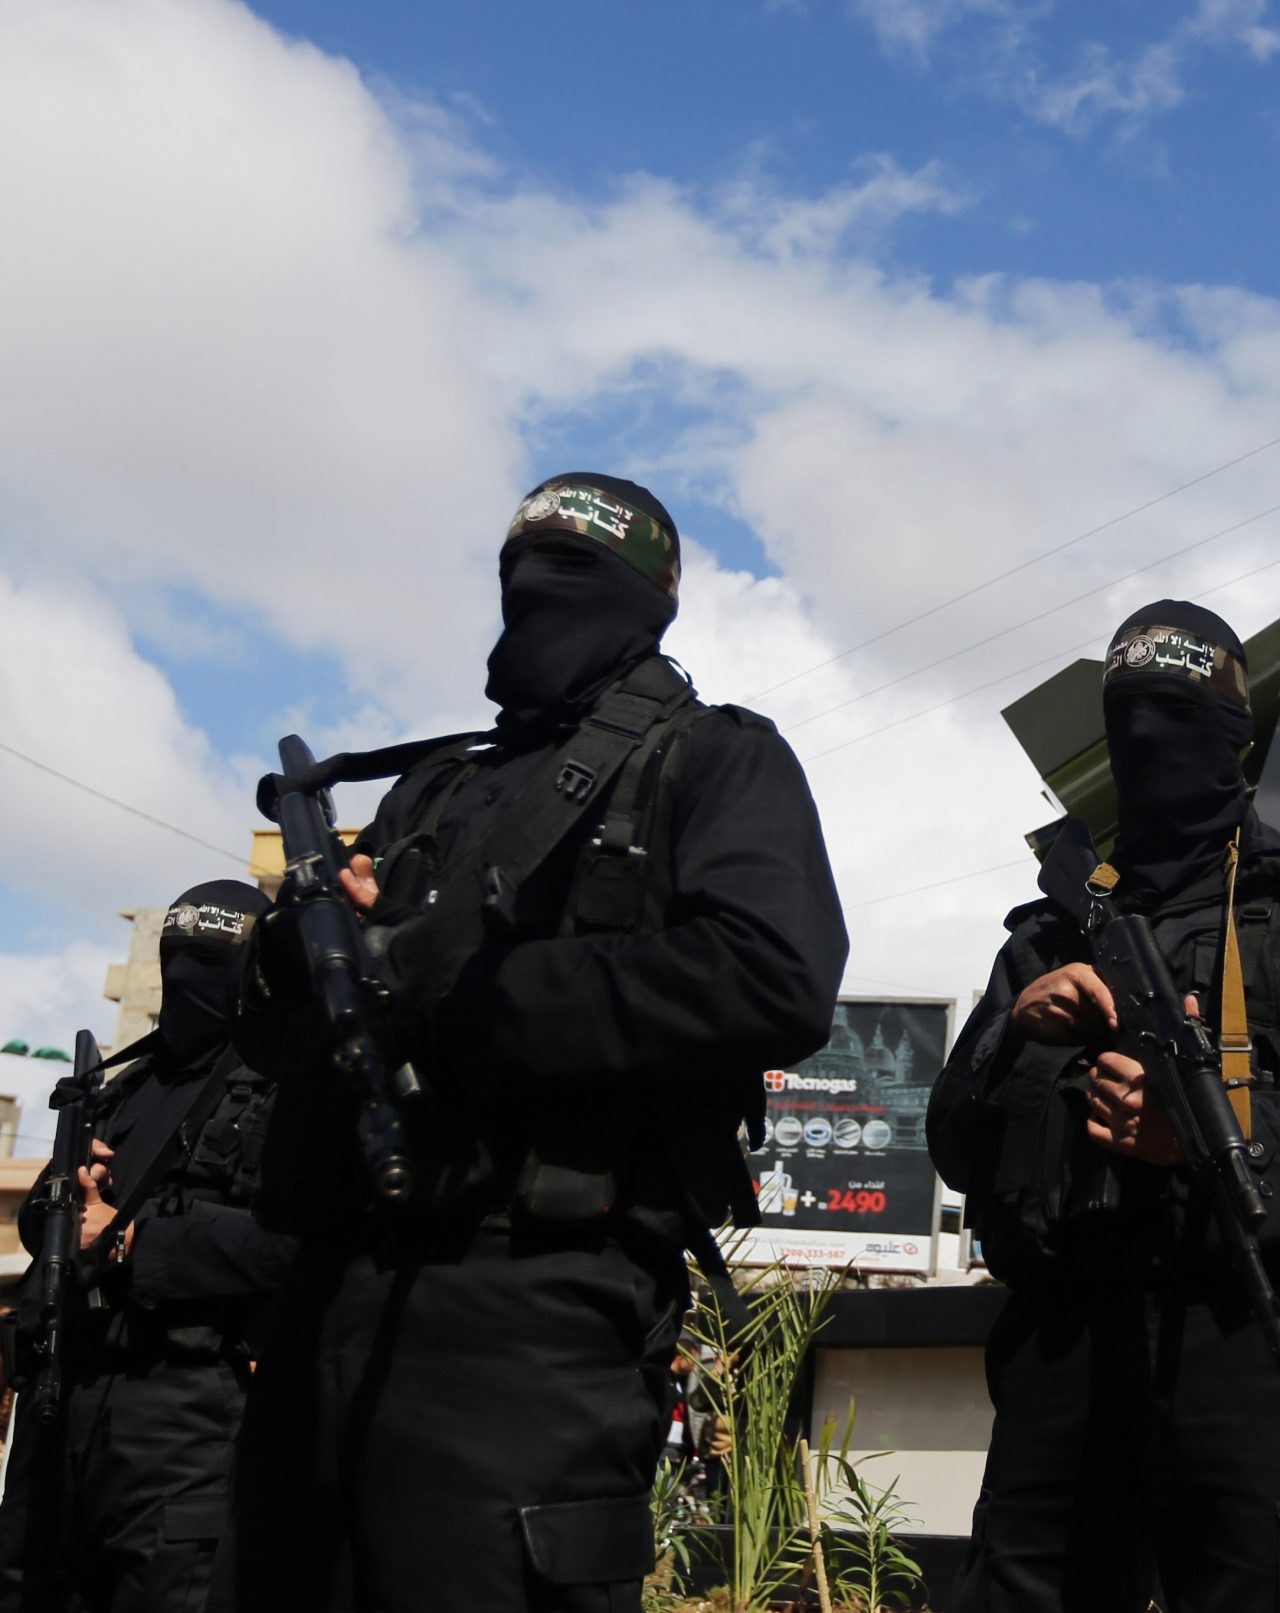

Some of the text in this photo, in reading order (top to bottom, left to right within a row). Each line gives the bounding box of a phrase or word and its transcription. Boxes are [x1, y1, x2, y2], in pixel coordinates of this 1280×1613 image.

[557, 505, 629, 541] كتائب
[1155, 650, 1214, 678] كتائب
[785, 1073, 857, 1093] Tecnogas
[828, 1189, 887, 1213] 2490
